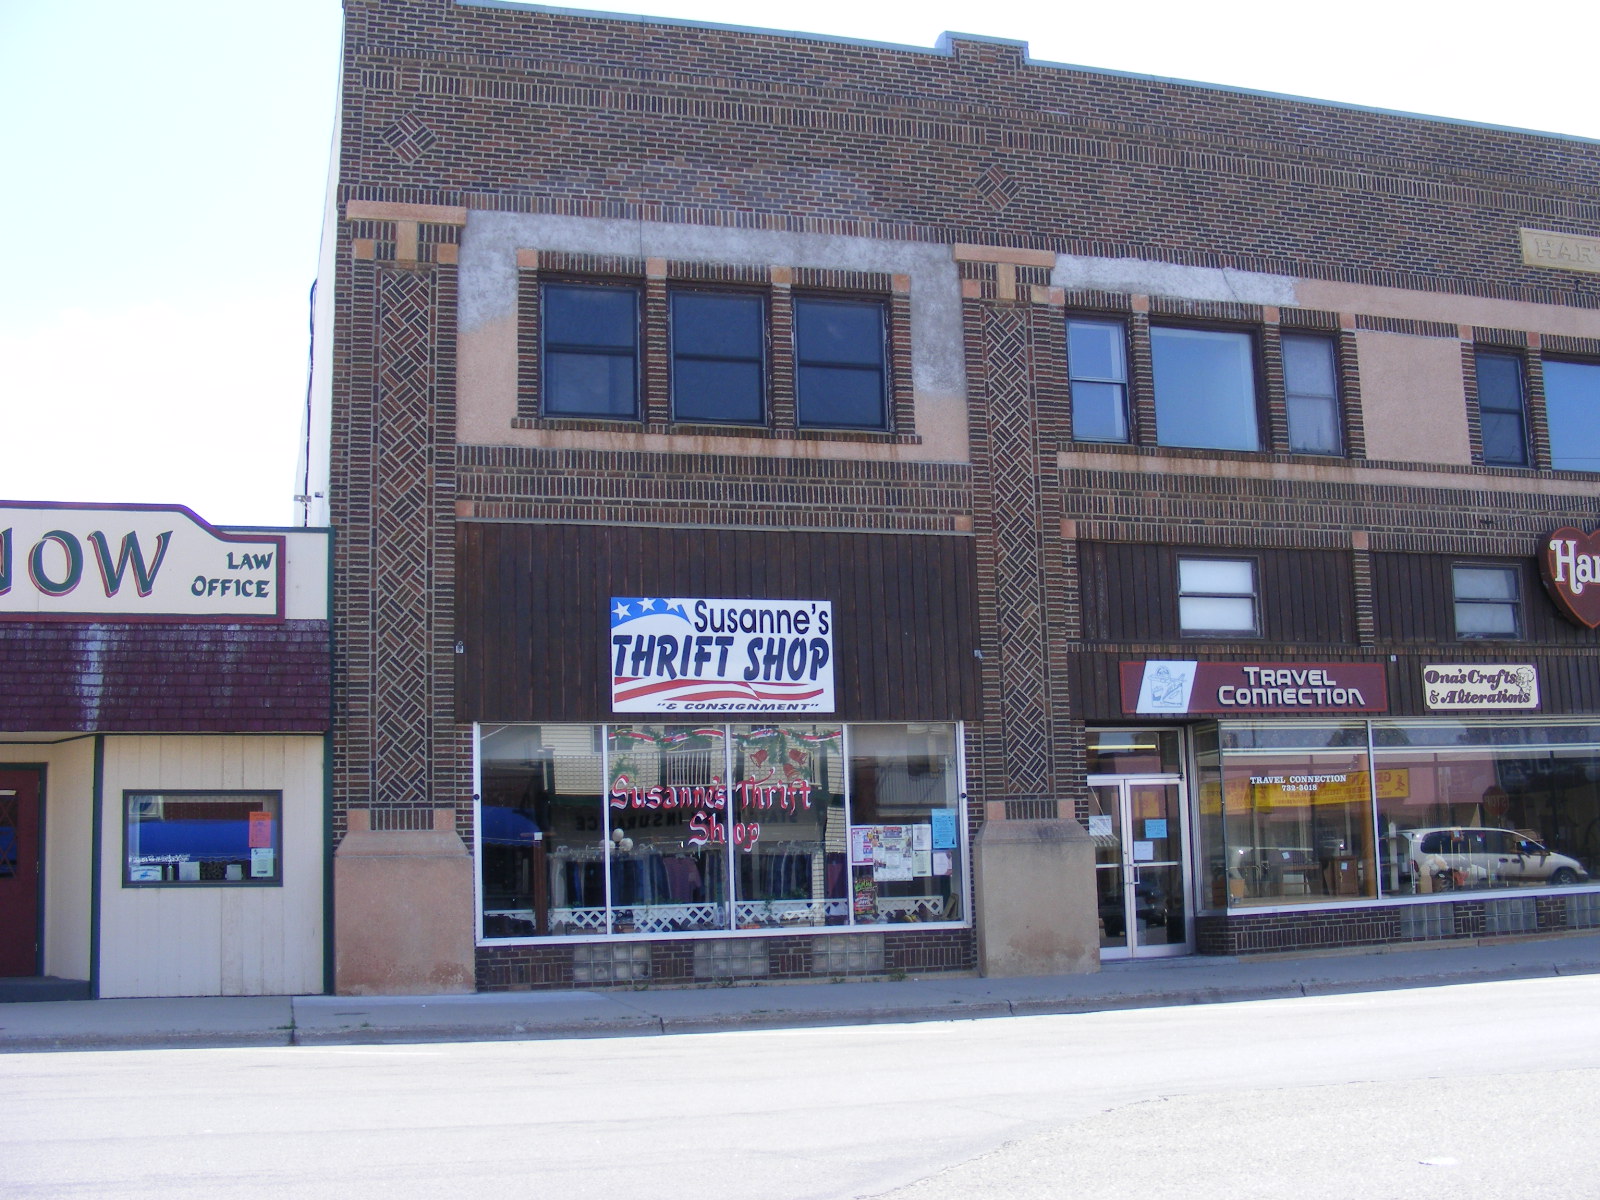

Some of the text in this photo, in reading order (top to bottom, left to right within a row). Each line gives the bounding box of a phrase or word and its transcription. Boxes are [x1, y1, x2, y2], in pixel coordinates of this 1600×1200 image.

[227, 551, 274, 570] LAW
[191, 576, 270, 598] OFFICE
[694, 600, 829, 635] Susanne's
[612, 635, 830, 681] THRIFT SHOP
[1243, 666, 1337, 687] TRAVEL
[1424, 668, 1518, 691] Ona's Crafts
[1218, 686, 1366, 706] CONNECTION
[1429, 689, 1531, 704] & Alterations
[1249, 774, 1347, 784] TRAVEL CONNECTION
[610, 766, 812, 816] Susanne's Thrift
[688, 810, 761, 853] Shop
